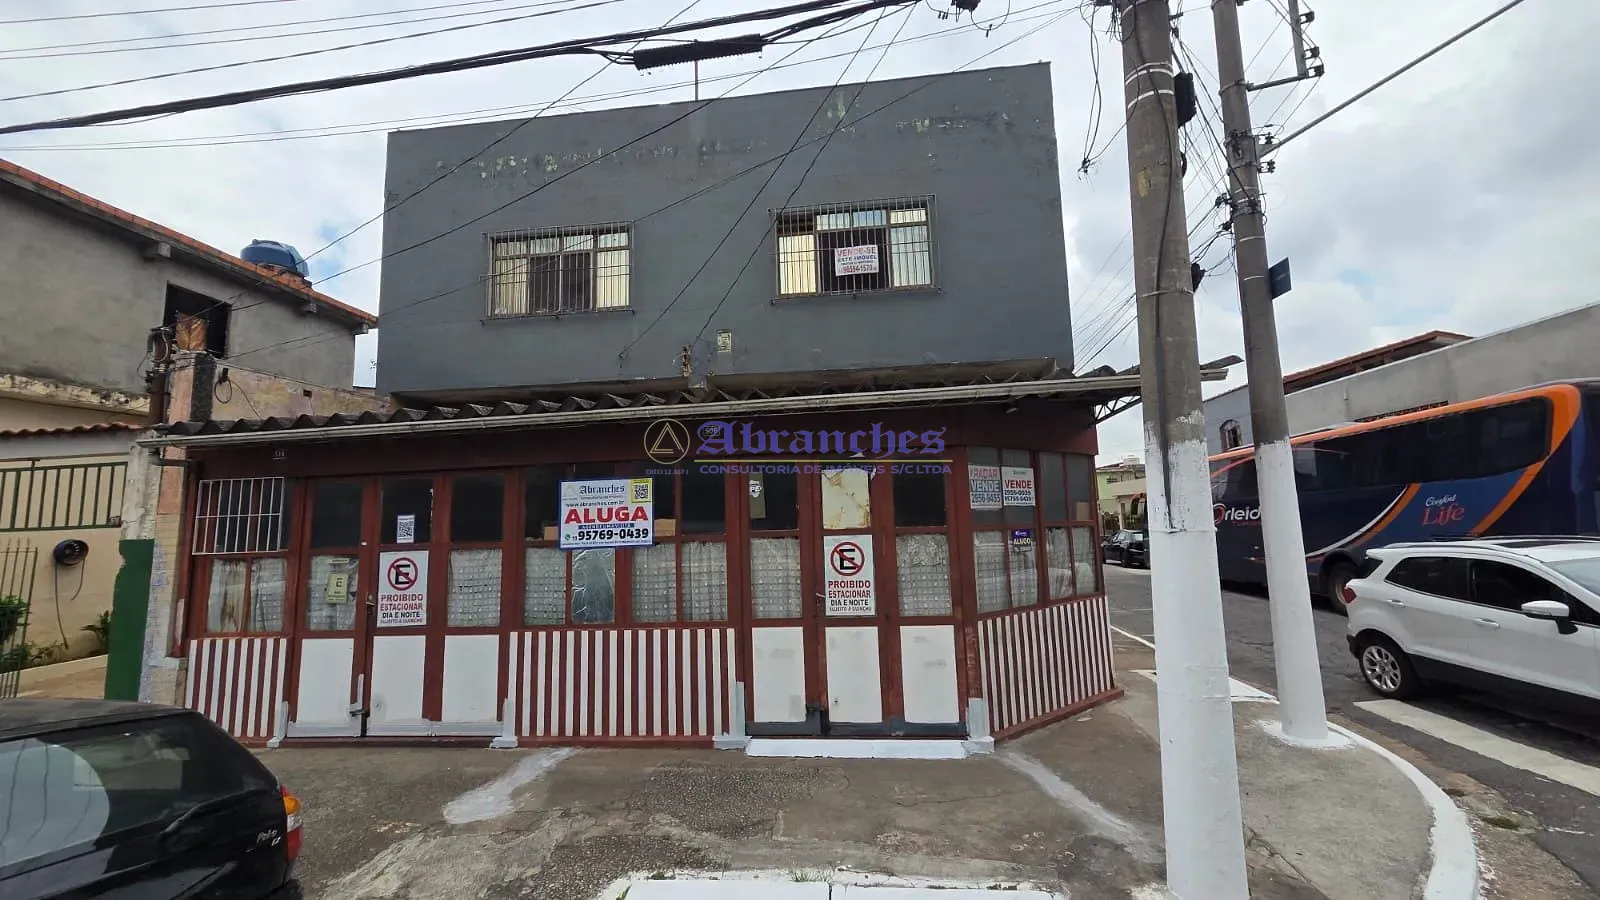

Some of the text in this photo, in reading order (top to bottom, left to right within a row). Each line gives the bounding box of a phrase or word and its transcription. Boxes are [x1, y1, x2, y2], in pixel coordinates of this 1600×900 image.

[579, 484, 625, 495] Abranches
[971, 480, 1000, 492] VENDE
[1004, 480, 1033, 489] VENDE
[564, 506, 649, 524] ALUGA
[1422, 503, 1465, 526] Life
[578, 528, 649, 541] 95769-0439
[828, 580, 871, 588] PROIBIDO
[380, 594, 424, 602] PROIBIDO
[828, 590, 871, 598] ESTACIONAR
[380, 602, 423, 611] ESTACIONAR
